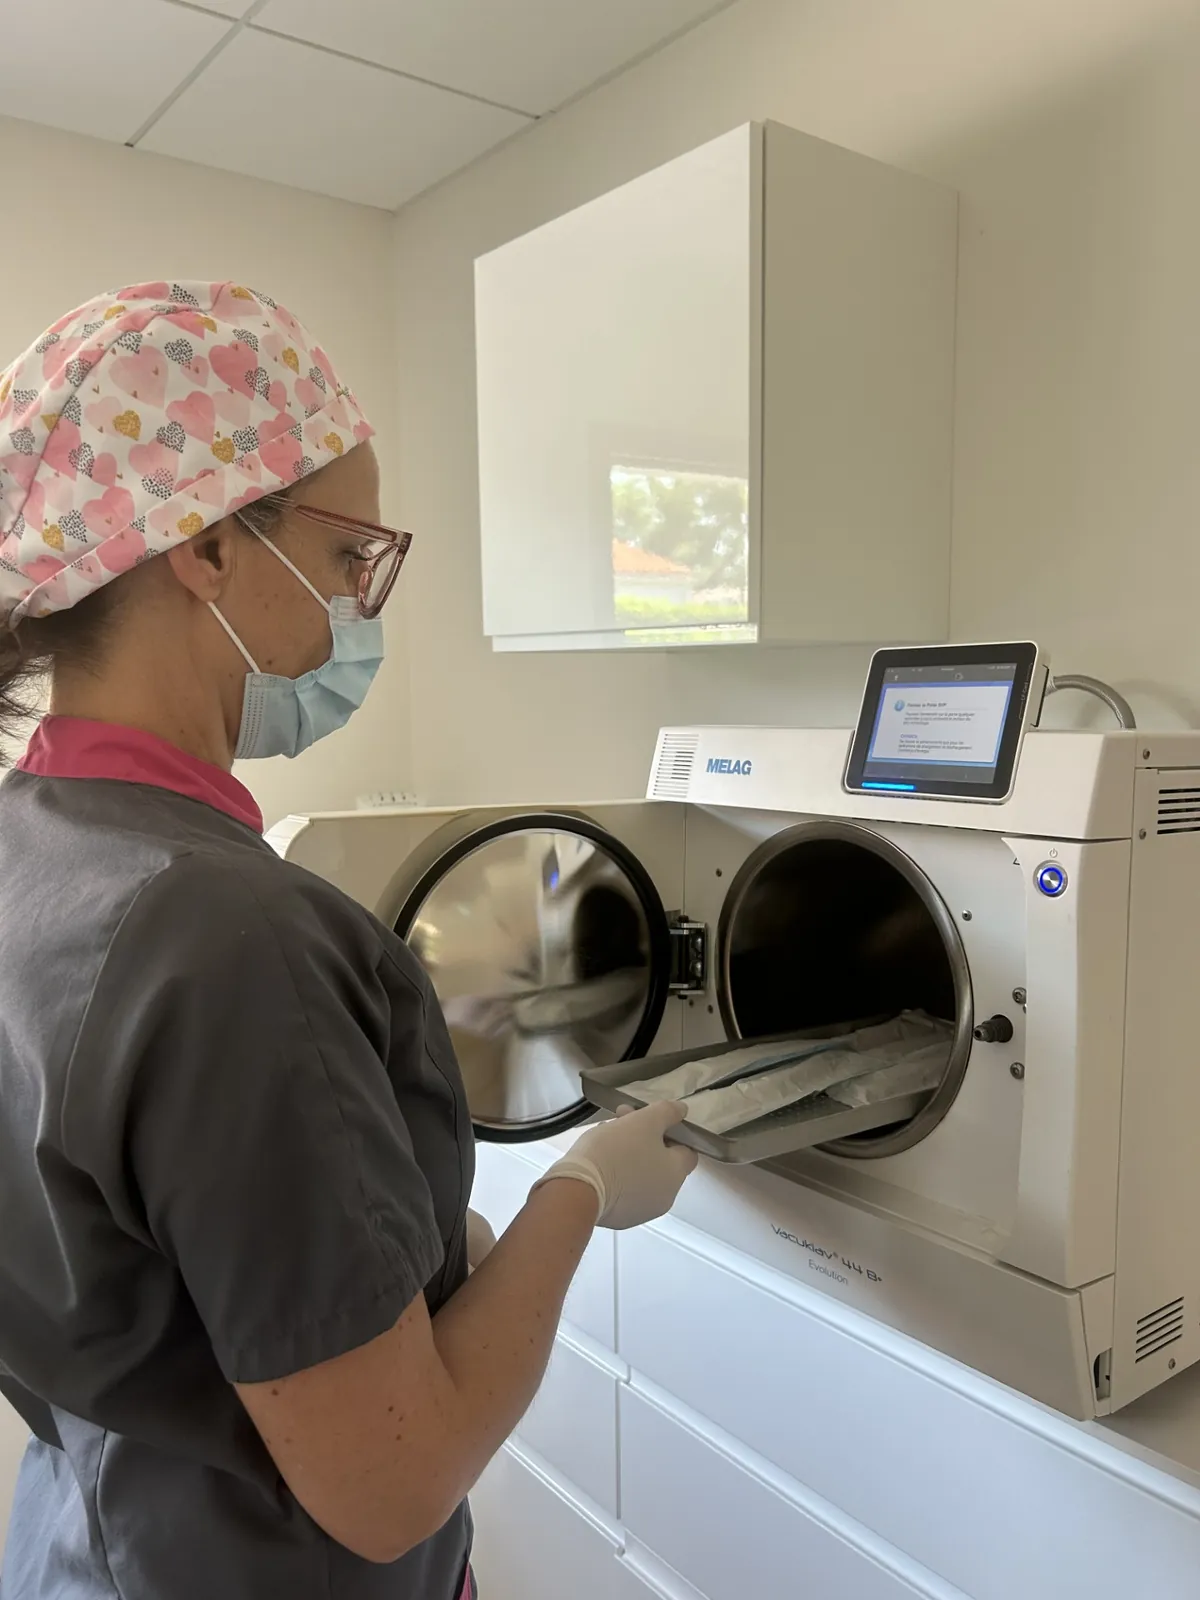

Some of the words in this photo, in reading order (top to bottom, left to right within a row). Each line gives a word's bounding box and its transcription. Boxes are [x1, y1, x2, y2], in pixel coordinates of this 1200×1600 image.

[706, 758, 752, 775] MELAG
[808, 1258, 848, 1286] Evolution
[841, 1257, 863, 1275] 44
